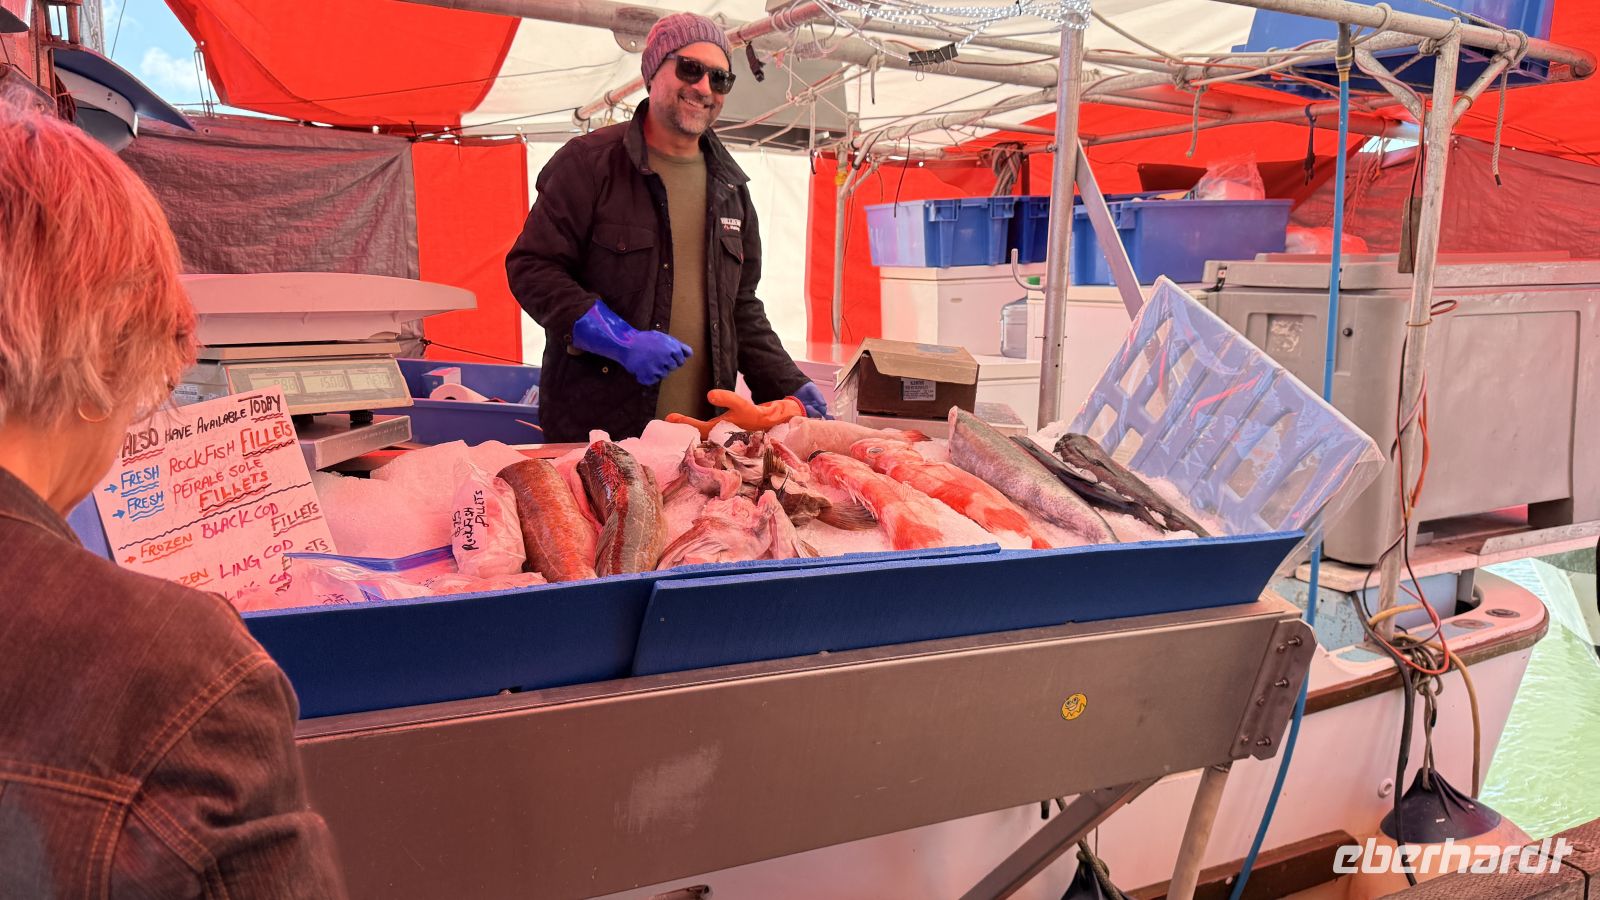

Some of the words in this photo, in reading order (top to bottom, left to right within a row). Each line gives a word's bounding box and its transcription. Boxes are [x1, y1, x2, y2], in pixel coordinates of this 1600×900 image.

[122, 428, 159, 458] ALSO
[165, 425, 193, 444] HAVE
[238, 394, 281, 416] TODAY
[121, 465, 160, 490] FRESH
[240, 420, 293, 453] FILLETS
[127, 490, 164, 515] FRESH
[229, 459, 263, 477] SOLE
[200, 471, 268, 508] FILLETS
[140, 533, 193, 558] FROZEN
[202, 510, 251, 539] BLACK
[254, 502, 279, 519] COD
[271, 503, 319, 530] FILLETS
[178, 568, 209, 586] ZEN
[219, 555, 262, 579] LING
[263, 539, 294, 559] COD
